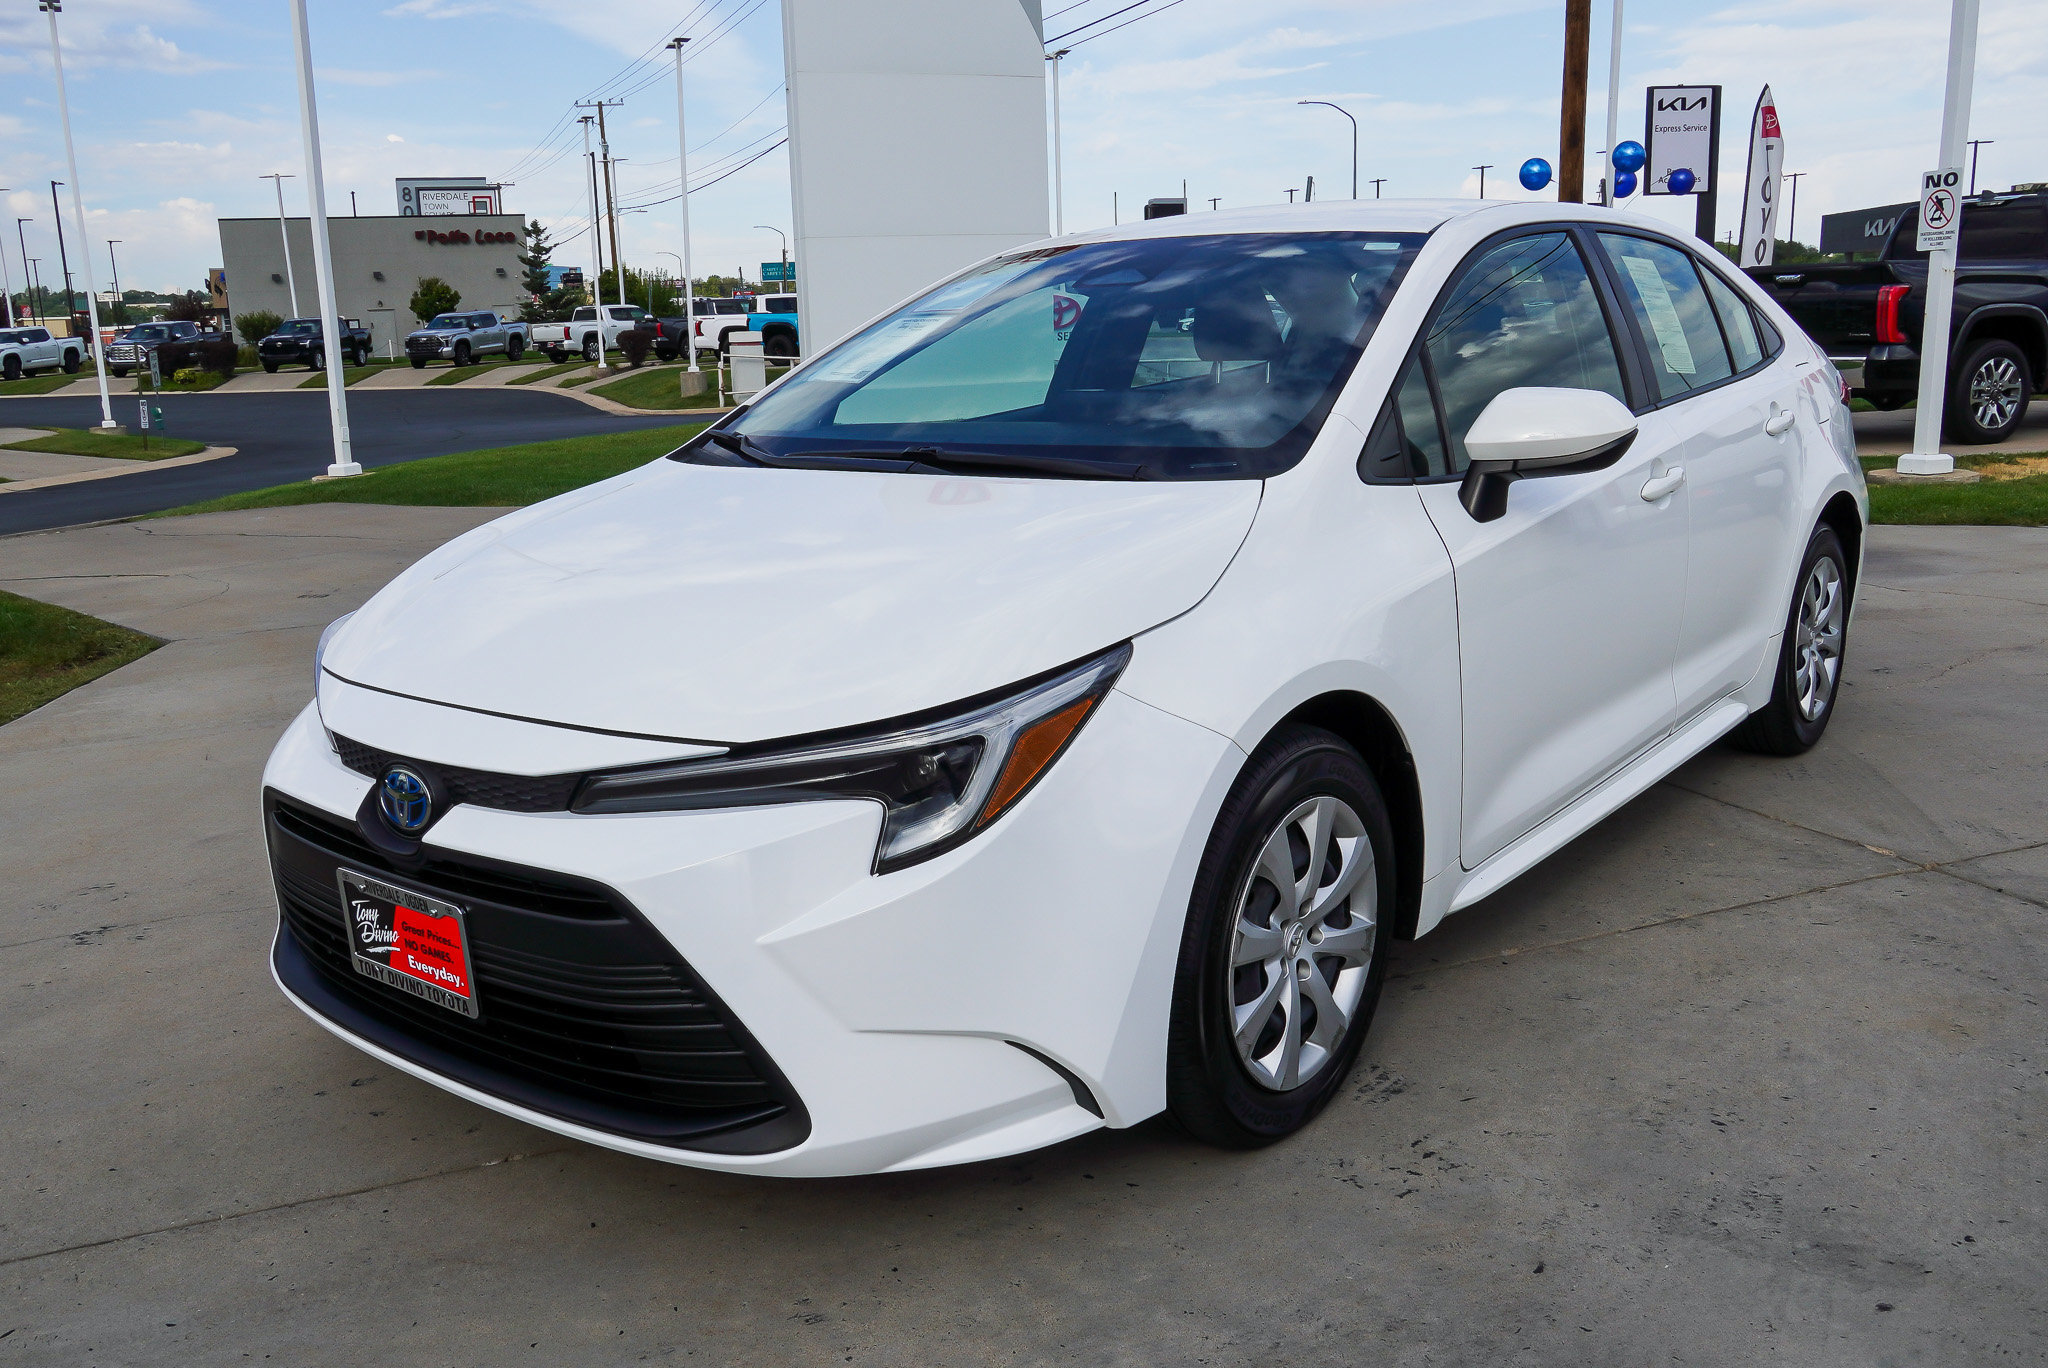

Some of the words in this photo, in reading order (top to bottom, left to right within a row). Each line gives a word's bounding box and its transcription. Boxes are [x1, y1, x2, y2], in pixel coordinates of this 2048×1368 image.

[1658, 96, 1707, 111] KIA
[1655, 124, 1681, 135] Express
[1682, 123, 1708, 132] Service
[1925, 172, 1958, 189] NO
[422, 192, 469, 201] RIVERDALE
[475, 229, 516, 243] Loco
[364, 879, 402, 904] RIVERDALE
[404, 893, 430, 913] OGDEN
[351, 899, 379, 926] Tony
[356, 921, 400, 943] Divino
[401, 920, 425, 938] Great
[404, 938, 418, 952] NO
[421, 944, 454, 964] GAMES.
[407, 954, 465, 988] Everyday.
[358, 959, 387, 981] TONY
[388, 971, 424, 996] DIVINO
[427, 983, 470, 1015] TOYOTA
